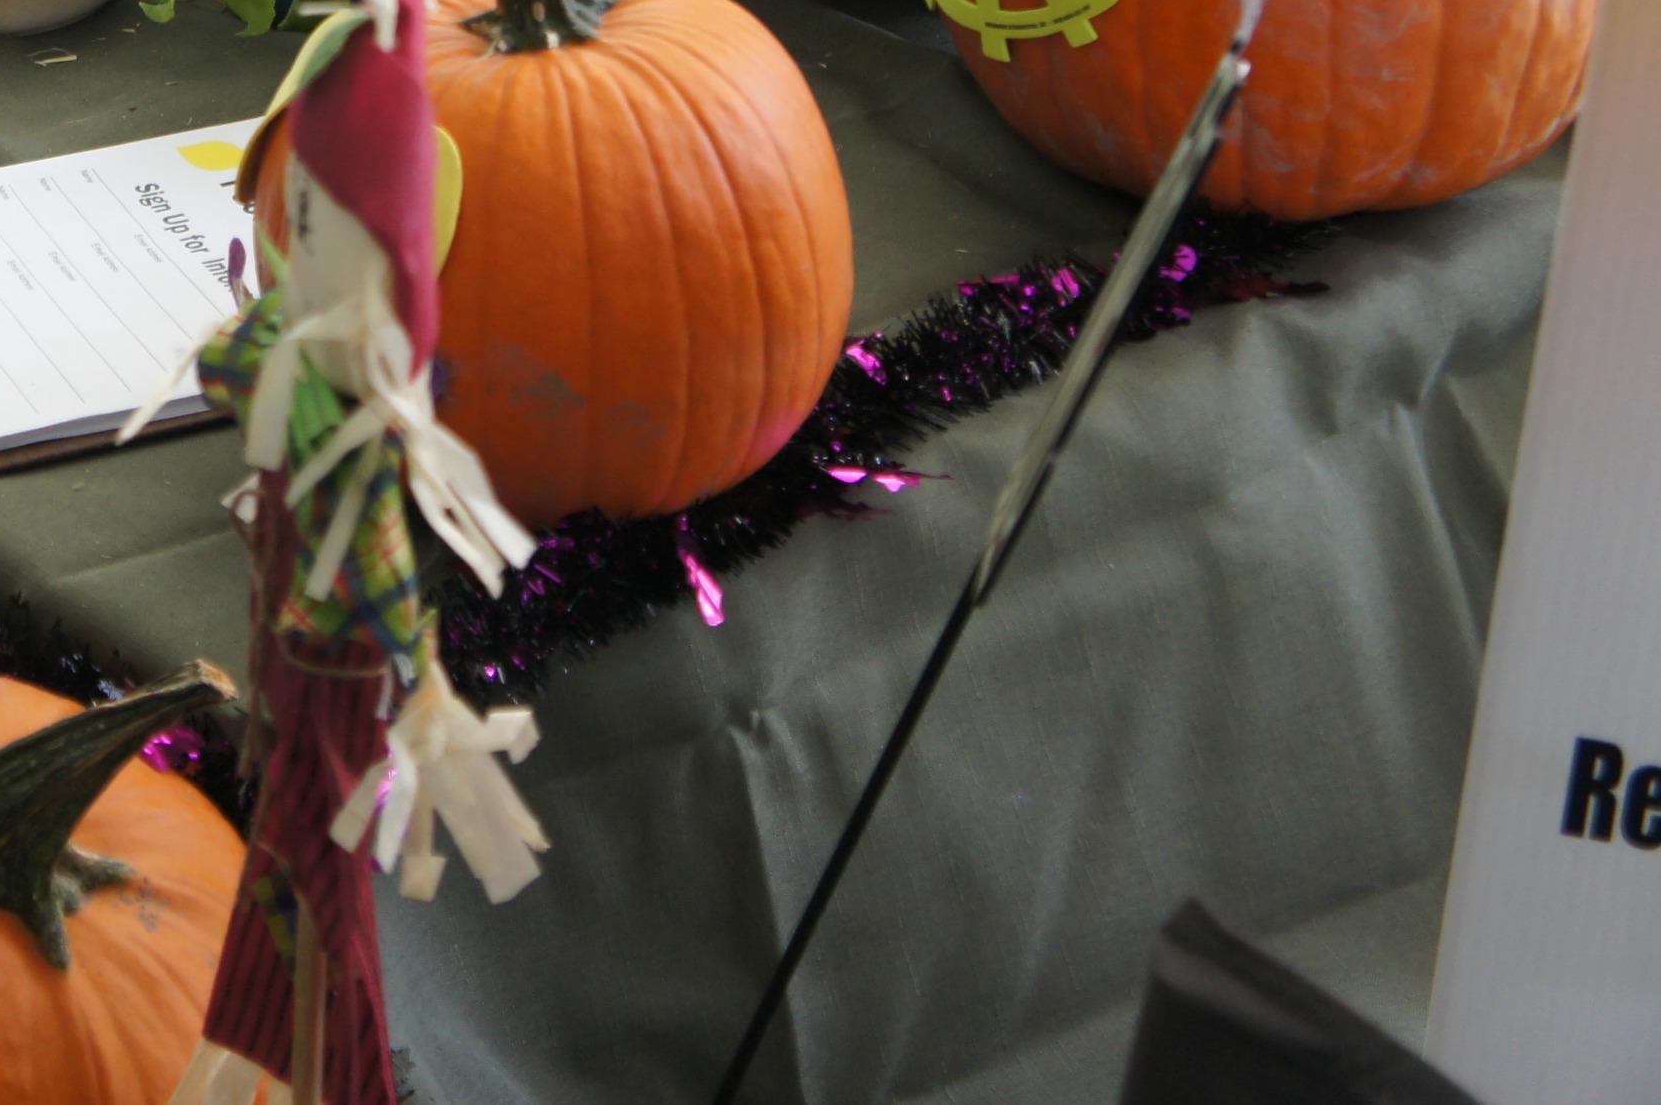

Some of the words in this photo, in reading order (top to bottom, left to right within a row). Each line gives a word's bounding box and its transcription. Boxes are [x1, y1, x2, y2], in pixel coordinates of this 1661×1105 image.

[134, 182, 173, 215] Sign
[162, 212, 191, 235] Up
[179, 233, 211, 254] for
[201, 257, 232, 293] Info
[1560, 735, 1661, 851] Re
